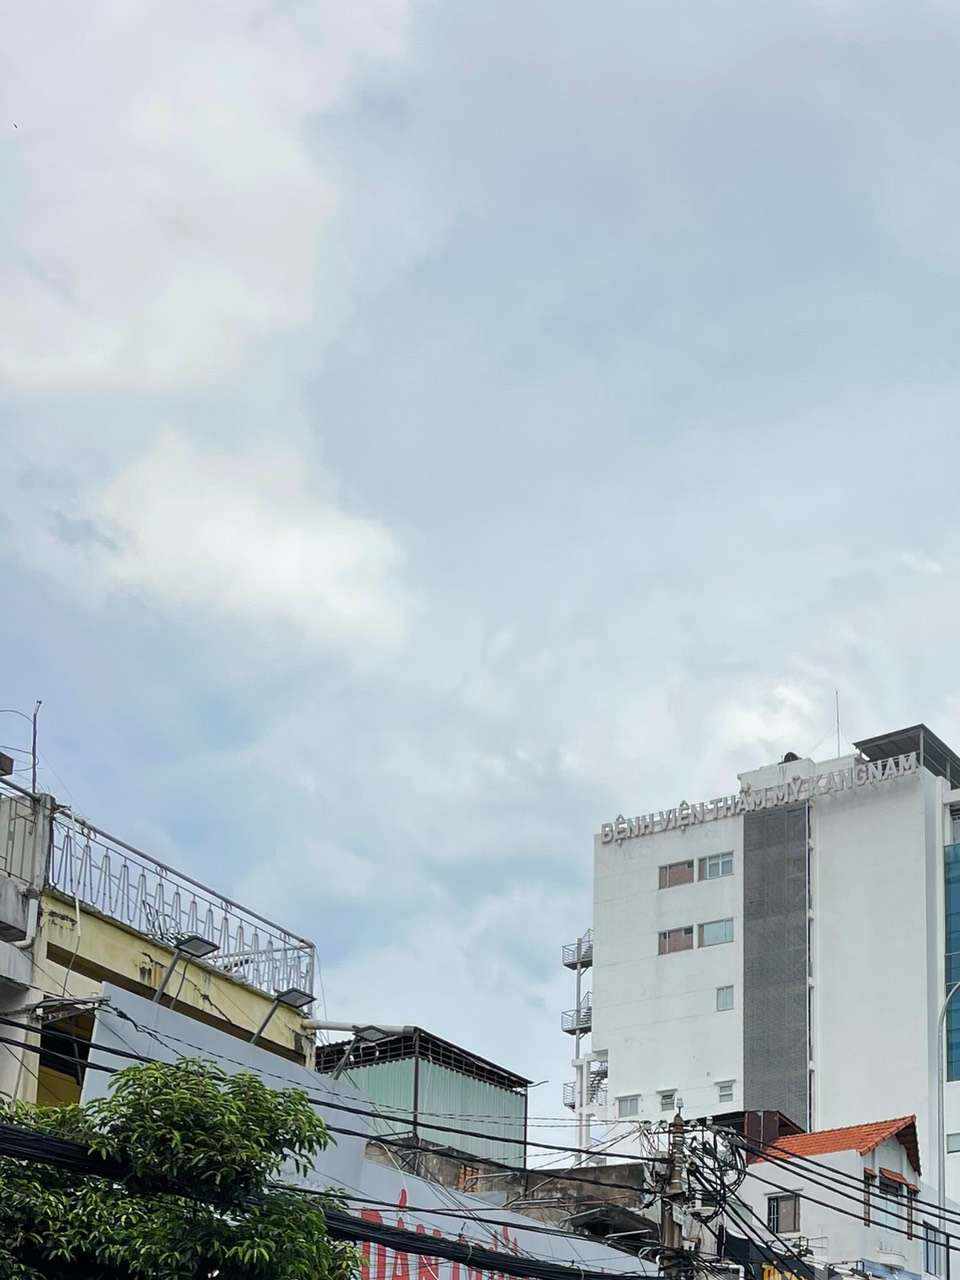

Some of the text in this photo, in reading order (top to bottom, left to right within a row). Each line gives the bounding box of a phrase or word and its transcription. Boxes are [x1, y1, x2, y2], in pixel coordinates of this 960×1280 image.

[600, 751, 917, 847] BỆNH VIỆN THẨM MỸ KANGNAM
